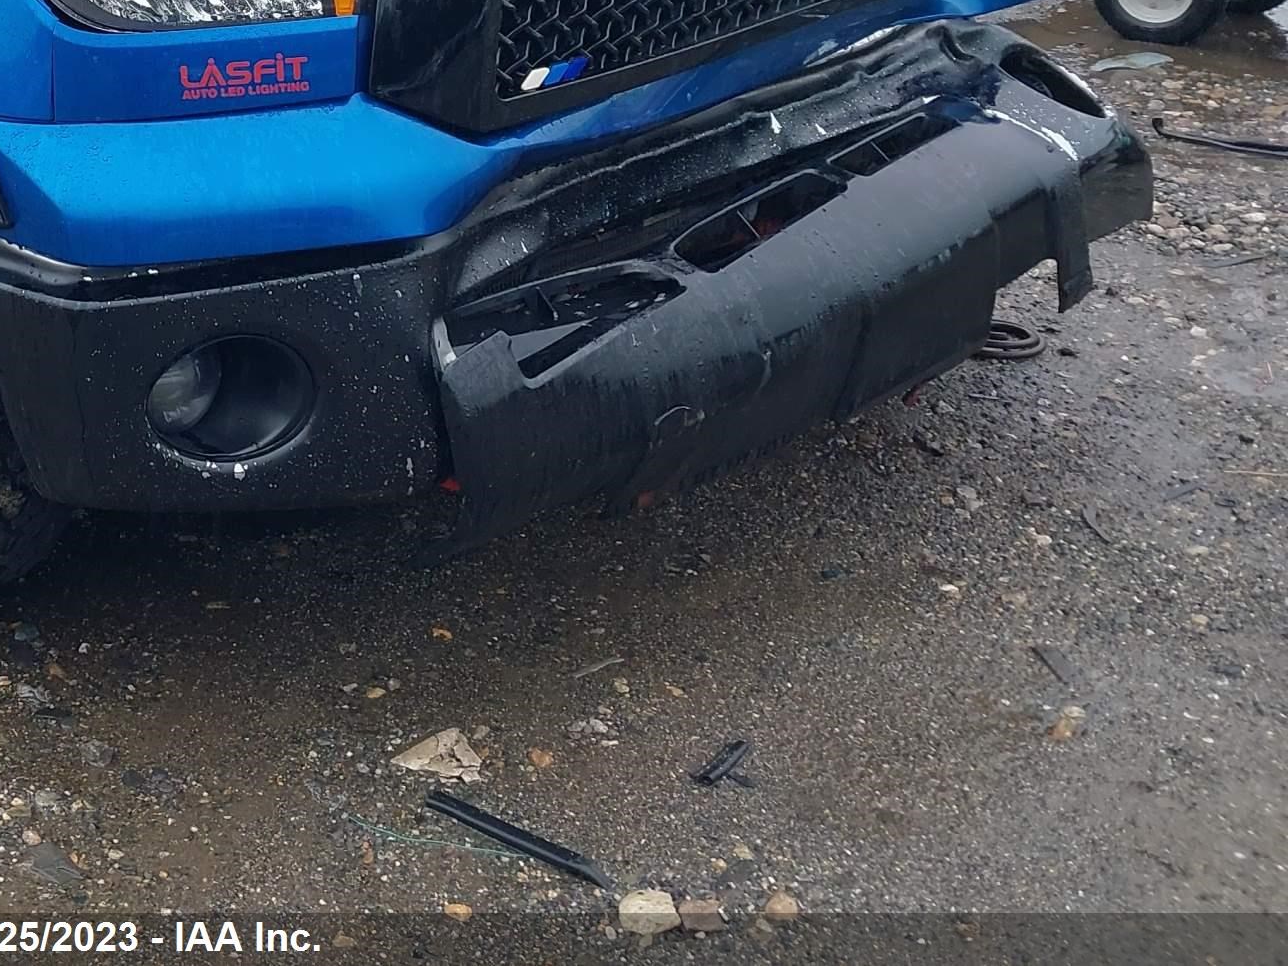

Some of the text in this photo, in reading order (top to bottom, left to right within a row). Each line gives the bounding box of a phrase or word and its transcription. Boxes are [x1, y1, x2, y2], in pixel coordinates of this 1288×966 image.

[182, 81, 309, 99] AUTO LED LIGHTING
